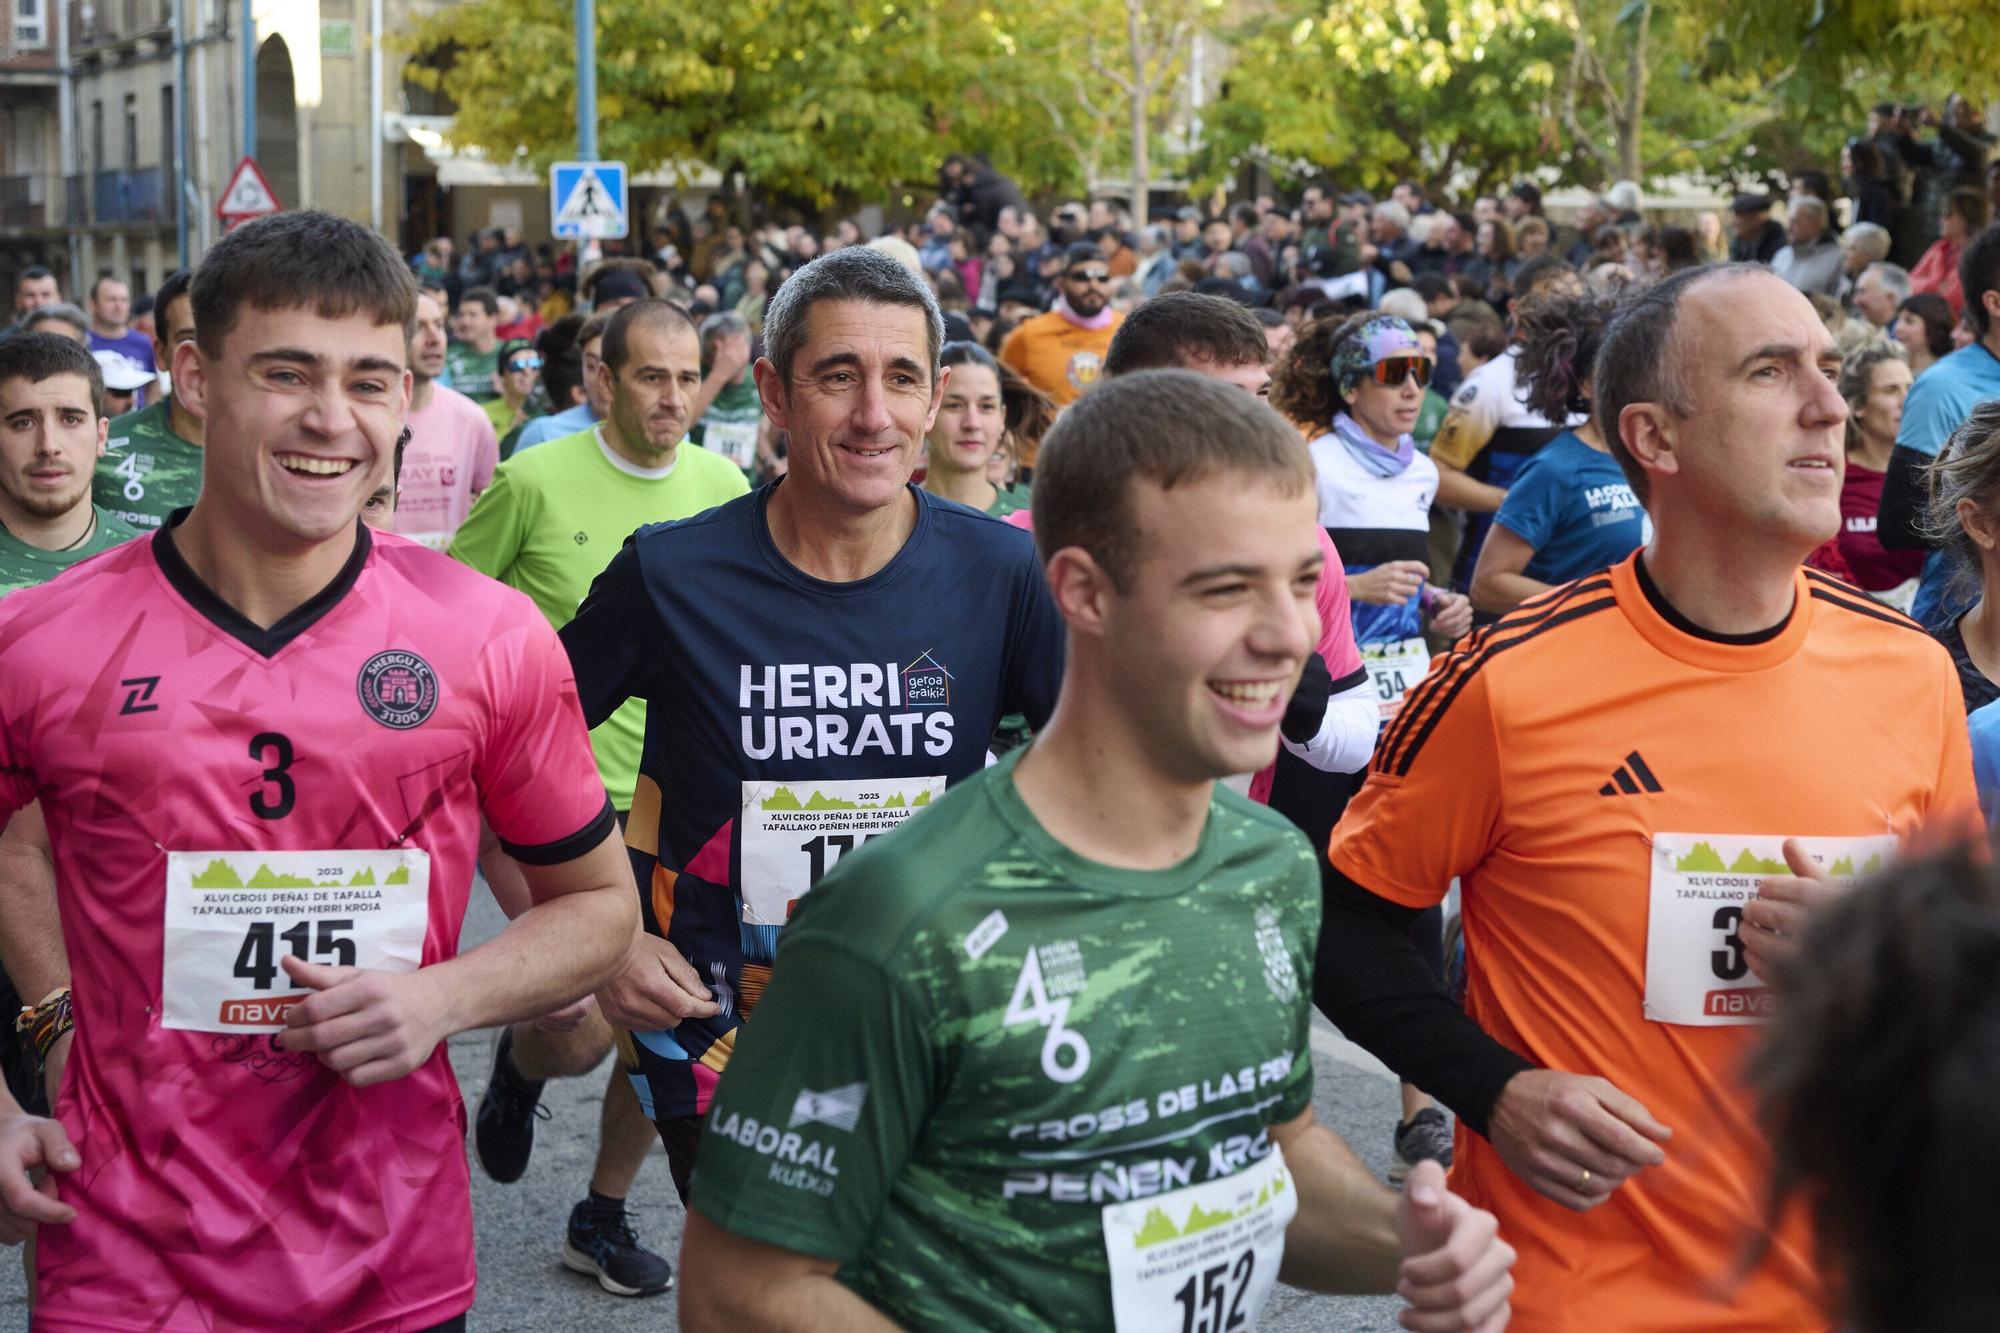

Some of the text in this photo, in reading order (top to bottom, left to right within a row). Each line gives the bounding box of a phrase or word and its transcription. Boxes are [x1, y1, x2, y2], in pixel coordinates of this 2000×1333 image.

[367, 655, 429, 676] SHERGU FC
[739, 662, 901, 709] HERRI
[909, 676, 943, 689] geroa
[909, 686, 945, 700] eraikiz
[380, 709, 420, 724] 31300
[741, 711, 954, 761] URRATS
[248, 732, 296, 821] 3
[771, 810, 910, 821] XLVI CROSS PEÑAS DE TAFALLA
[763, 822, 817, 831] TAFALLAKO
[819, 820, 850, 830] PEÑEN
[852, 821, 880, 830] HERRI
[317, 868, 343, 876] 2025
[1715, 877, 1749, 887] CROSS
[232, 892, 267, 902] CROSS
[272, 890, 309, 902] PEÑAS
[313, 891, 329, 901] DE
[333, 890, 382, 900] TAFALLA
[1677, 889, 1744, 900] TAFALLAKO
[192, 902, 380, 915] TAFALLAKO PEÑEN HERRI KROSA
[233, 919, 356, 990] 415
[1002, 944, 1091, 1083] 46
[1157, 1084, 1198, 1118] DE
[1203, 1066, 1256, 1102] LAS
[711, 1105, 840, 1176] LABORAL
[1002, 1156, 1197, 1203] PEÑEN
[1175, 1248, 1255, 1333] 152
